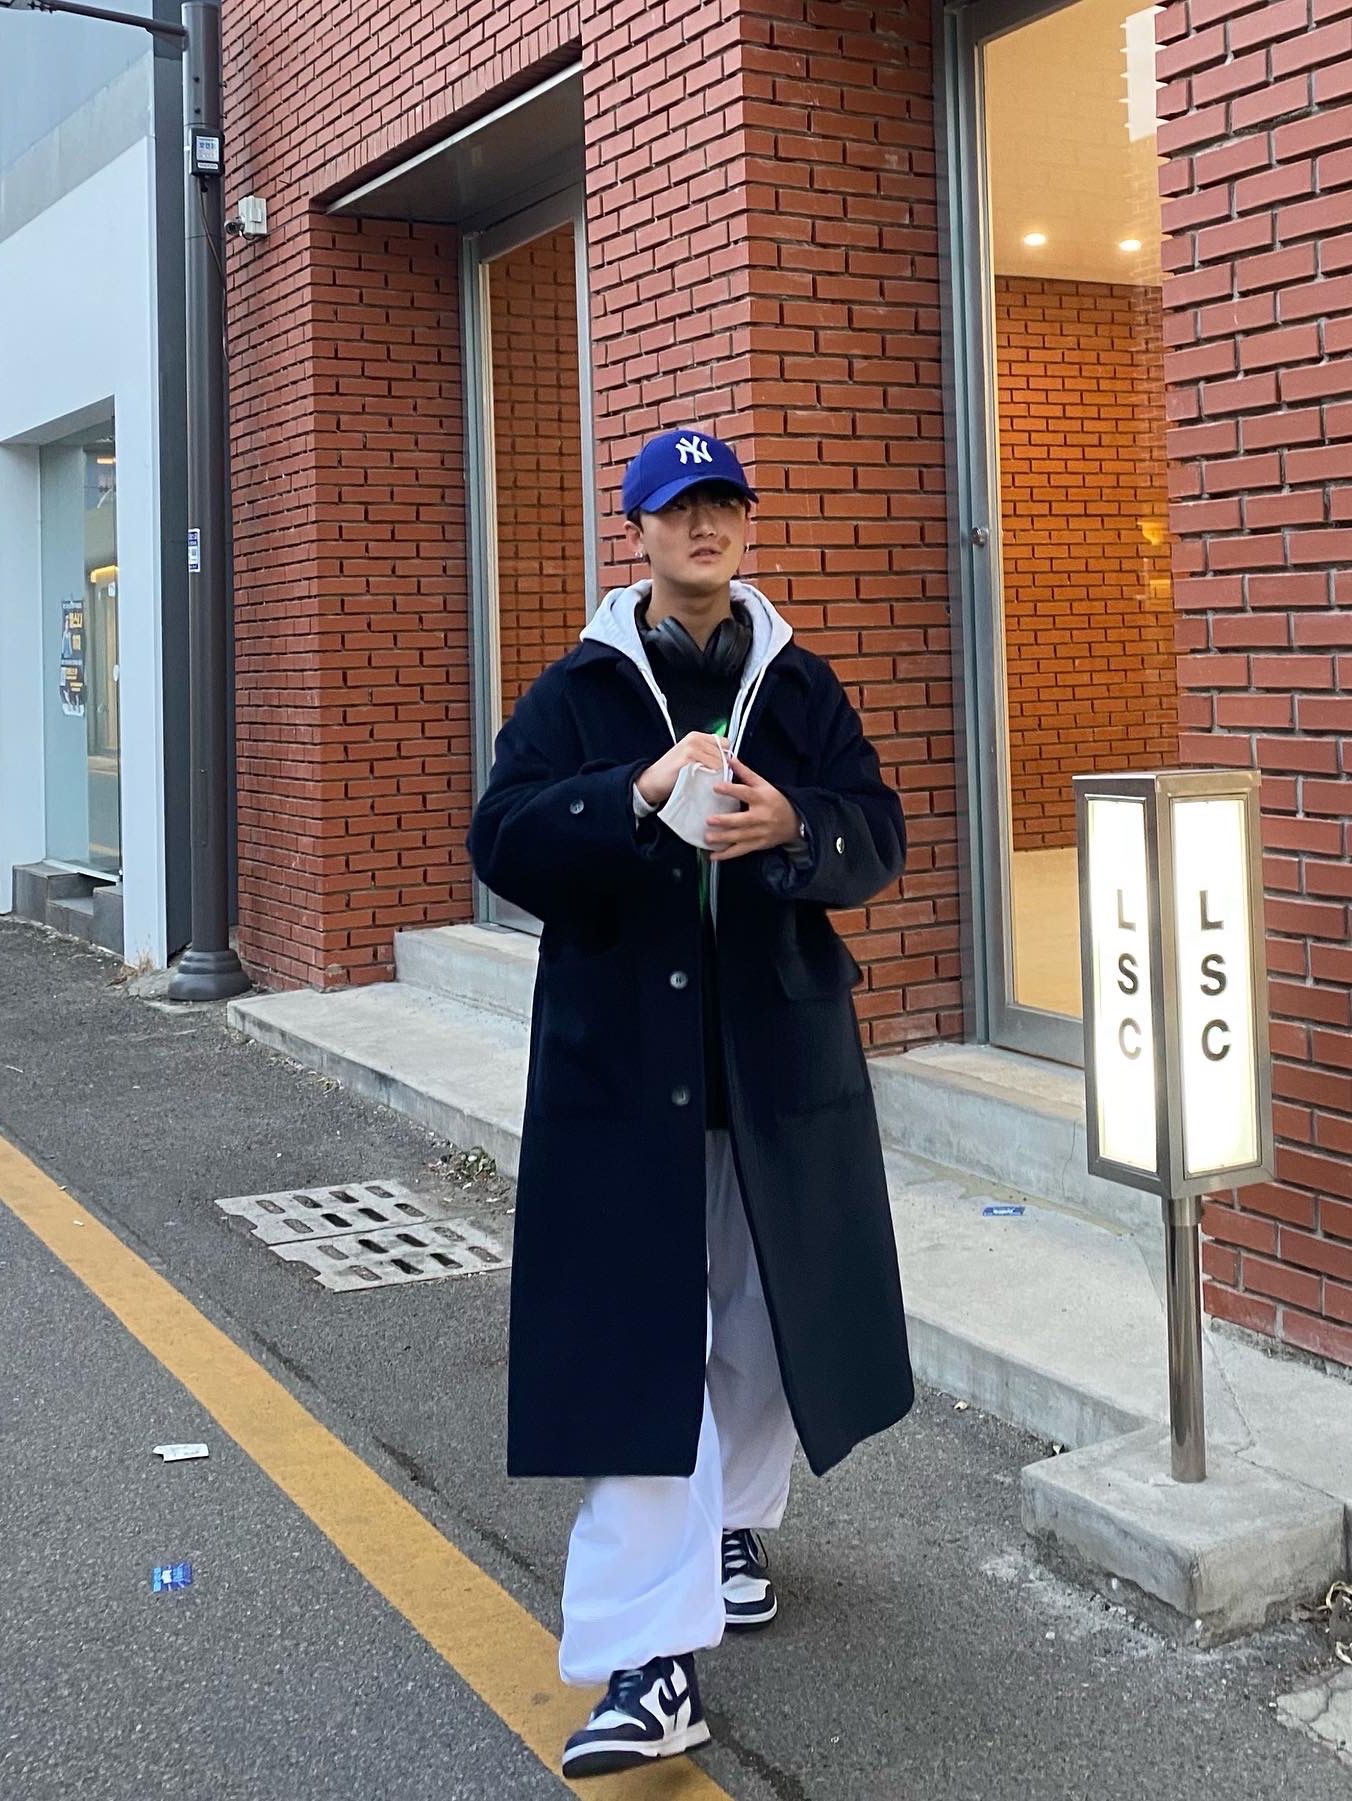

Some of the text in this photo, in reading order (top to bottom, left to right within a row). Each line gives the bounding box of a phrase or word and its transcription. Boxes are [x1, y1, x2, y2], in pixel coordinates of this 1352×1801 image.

[675, 435, 713, 464] NY
[1117, 889, 1142, 1060] LSC
[1199, 889, 1231, 1061] LSC
